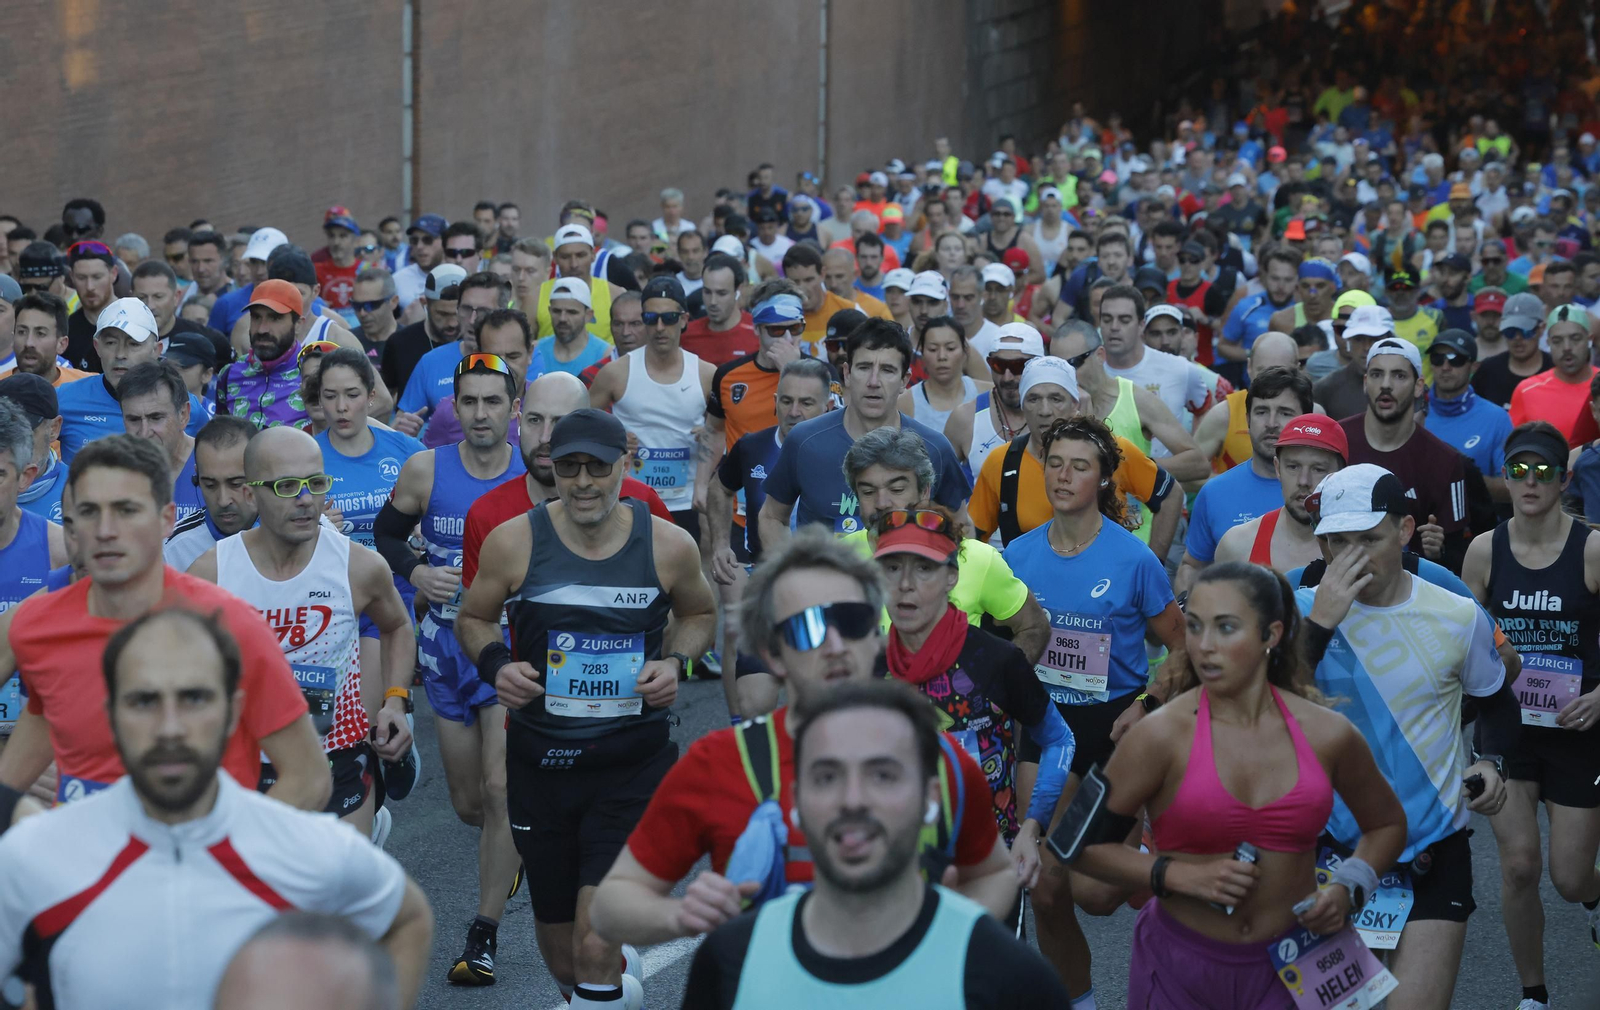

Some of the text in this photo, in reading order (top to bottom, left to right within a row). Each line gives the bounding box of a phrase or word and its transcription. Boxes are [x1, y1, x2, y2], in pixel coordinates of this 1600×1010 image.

[653, 451, 684, 459] ZURICH
[381, 463, 399, 476] 20
[653, 466, 670, 474] 5163
[645, 476, 676, 487] TIAGO
[614, 593, 648, 604] ANR
[1503, 590, 1562, 611] Julia
[1056, 614, 1102, 629] ZURICH
[1539, 619, 1580, 634] RUNS
[582, 638, 632, 651] ZURICH
[1056, 636, 1080, 650] 9683
[1047, 650, 1087, 670] RUTH
[1528, 656, 1573, 671] ZURICH
[581, 663, 609, 675] 7283
[293, 670, 326, 683] RICH
[1526, 677, 1551, 689] 9967
[568, 679, 620, 697] FAHRI
[1519, 691, 1558, 709] JULIA
[547, 749, 582, 757] COMP
[541, 758, 574, 766] RESS
[1316, 948, 1345, 973] 9588
[1315, 960, 1364, 1007] HELEN
